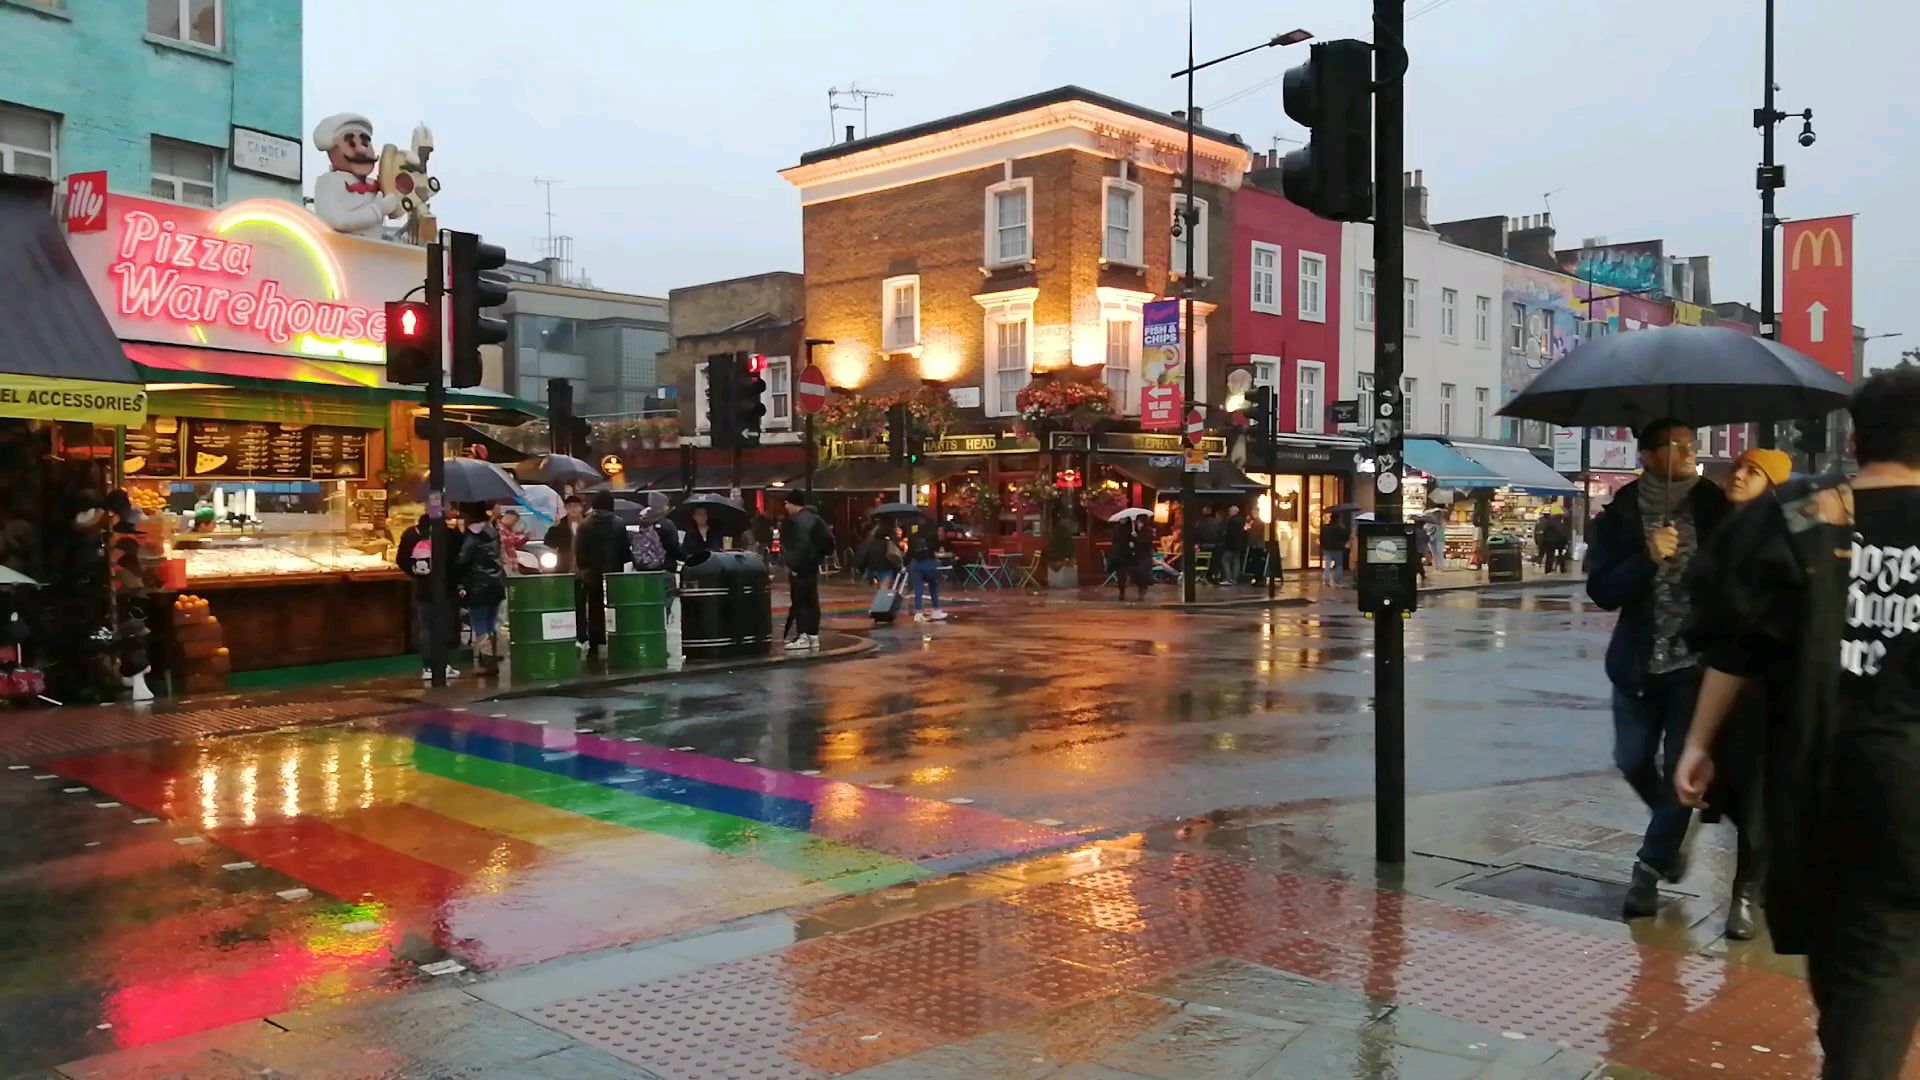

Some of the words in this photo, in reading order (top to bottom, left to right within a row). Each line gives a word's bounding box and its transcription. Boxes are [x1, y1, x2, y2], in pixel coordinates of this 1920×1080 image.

[69, 180, 103, 225] illy
[120, 209, 253, 277] Pizza
[112, 262, 386, 344] Warehouse
[1144, 325, 1167, 336] FISH
[1168, 323, 1177, 334] &
[1144, 333, 1178, 344] CHIPS
[27, 390, 142, 412] ACCESSORIES
[966, 438, 996, 450] HEAD
